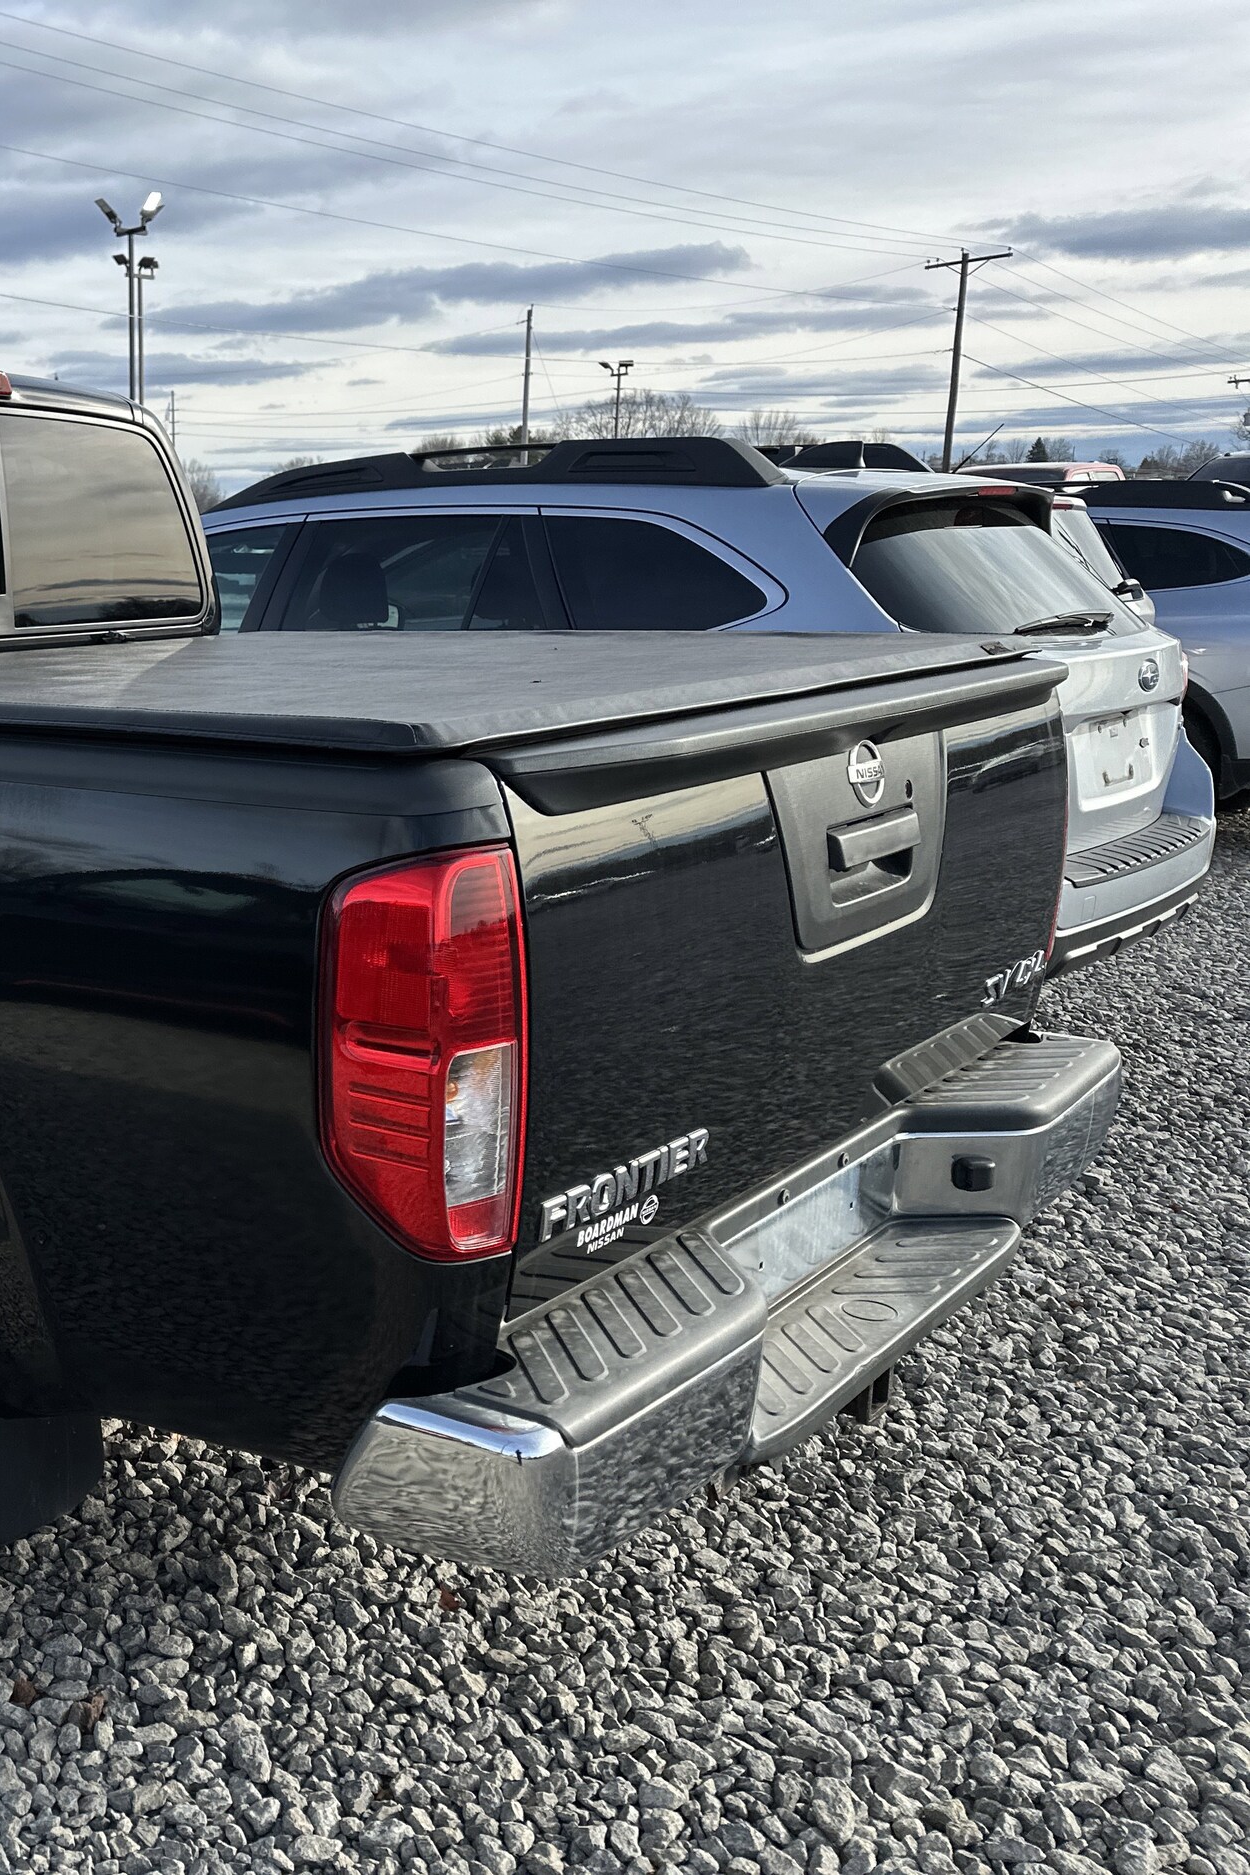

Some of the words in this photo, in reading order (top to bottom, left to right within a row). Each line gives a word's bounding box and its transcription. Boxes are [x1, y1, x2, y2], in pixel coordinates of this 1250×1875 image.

[540, 1128, 710, 1243] FRONTIER
[576, 1202, 639, 1248] BOARDMAN
[586, 1227, 625, 1255] NISSAN
